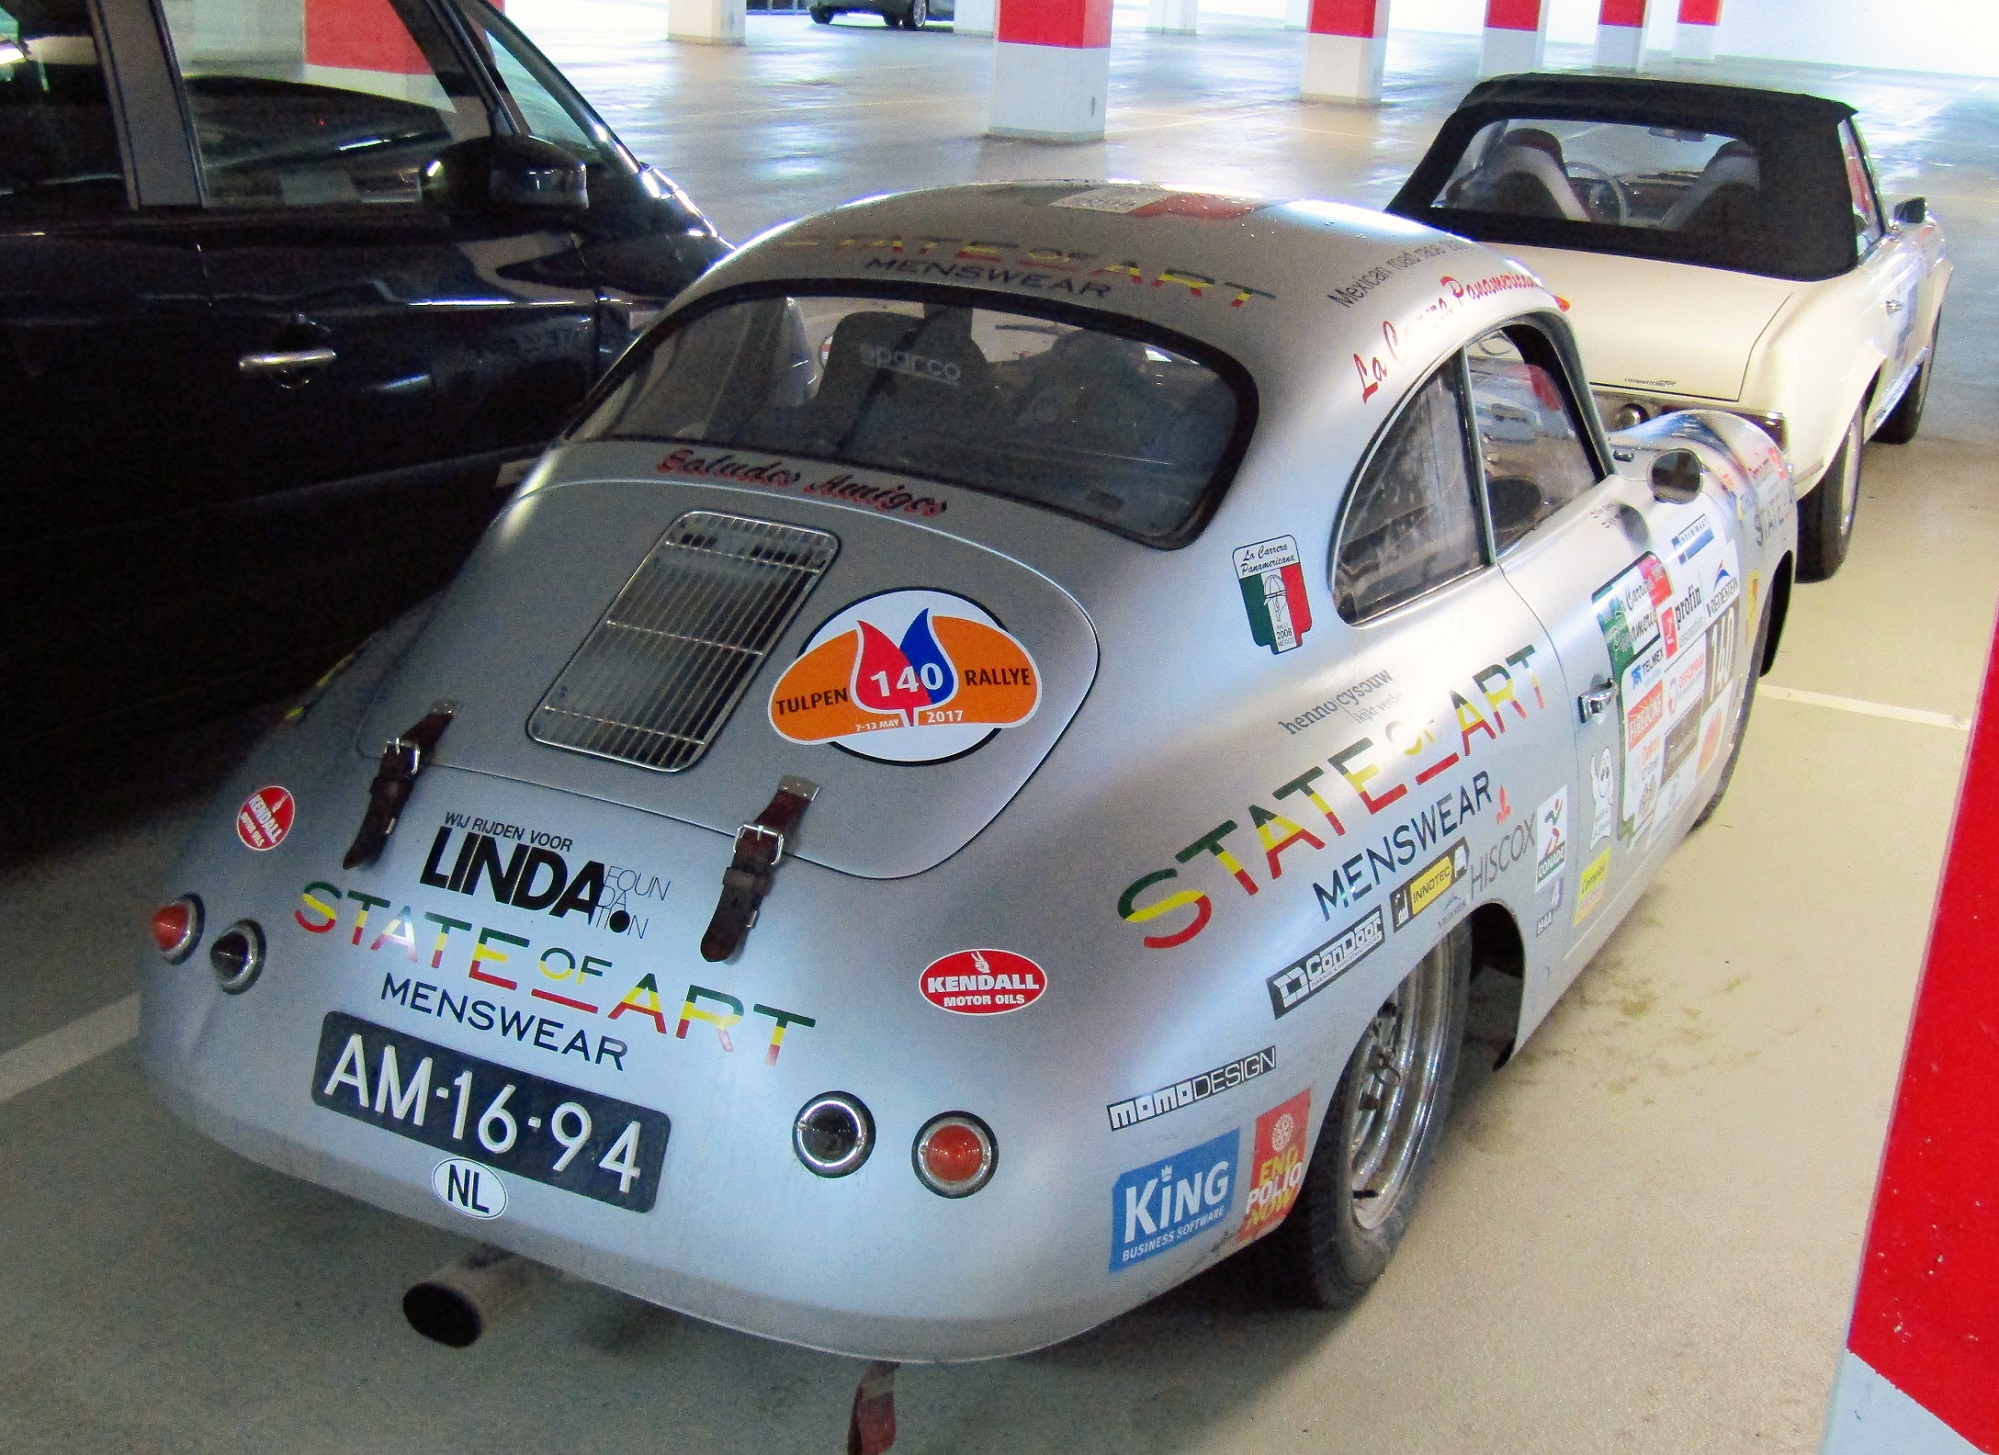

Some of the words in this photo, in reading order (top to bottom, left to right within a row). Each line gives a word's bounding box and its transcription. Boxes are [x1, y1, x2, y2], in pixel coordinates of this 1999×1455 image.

[865, 256, 1112, 299] MENSWEAR
[1095, 260, 1277, 308] ART
[1327, 266, 1394, 308] Mexican
[1353, 353, 1388, 404] La
[1440, 270, 1552, 308] Panamerican
[656, 449, 800, 487] Saludos
[803, 473, 948, 518] Amigos
[1240, 553, 1295, 576] Panamericana
[1242, 549, 1256, 561] La
[1258, 543, 1288, 560] Carrera
[1674, 583, 1702, 631] profin
[1276, 627, 1293, 640] 2008
[1641, 647, 1665, 676] TELMEX
[775, 687, 849, 715] TULPEN
[870, 662, 944, 697] 140
[964, 667, 1031, 687] RALLYE
[855, 722, 877, 731] 7-13
[880, 718, 899, 728] MAY
[926, 709, 964, 723] 2017
[1117, 736, 1408, 949] STATE
[1448, 643, 1546, 757] ART
[444, 811, 471, 829] WIJ
[471, 817, 526, 842] RIJDEN
[529, 829, 574, 853] VOOR
[1312, 770, 1493, 922] MENSWEAR
[419, 825, 606, 926] LINDA
[1470, 812, 1536, 901] HISCOX
[602, 865, 671, 902] FOUN
[1412, 865, 1451, 904] INNOTEC
[294, 881, 531, 991] STATE
[538, 946, 614, 986] OF
[607, 972, 817, 1067] ART
[927, 973, 1040, 993] KENDALL
[380, 971, 629, 1072] MENSWEAR
[943, 994, 992, 1007] MOTOR
[995, 993, 1025, 1005] OILS
[323, 1032, 642, 1194] AM-16-94
[447, 1163, 490, 1215] NL
[1245, 1162, 1303, 1215] POLIO
[1259, 1143, 1299, 1187] END
[1122, 1230, 1175, 1262] BUSINESS
[1175, 1204, 1225, 1239] SOFTWARE
[1244, 1188, 1292, 1231] NOW
